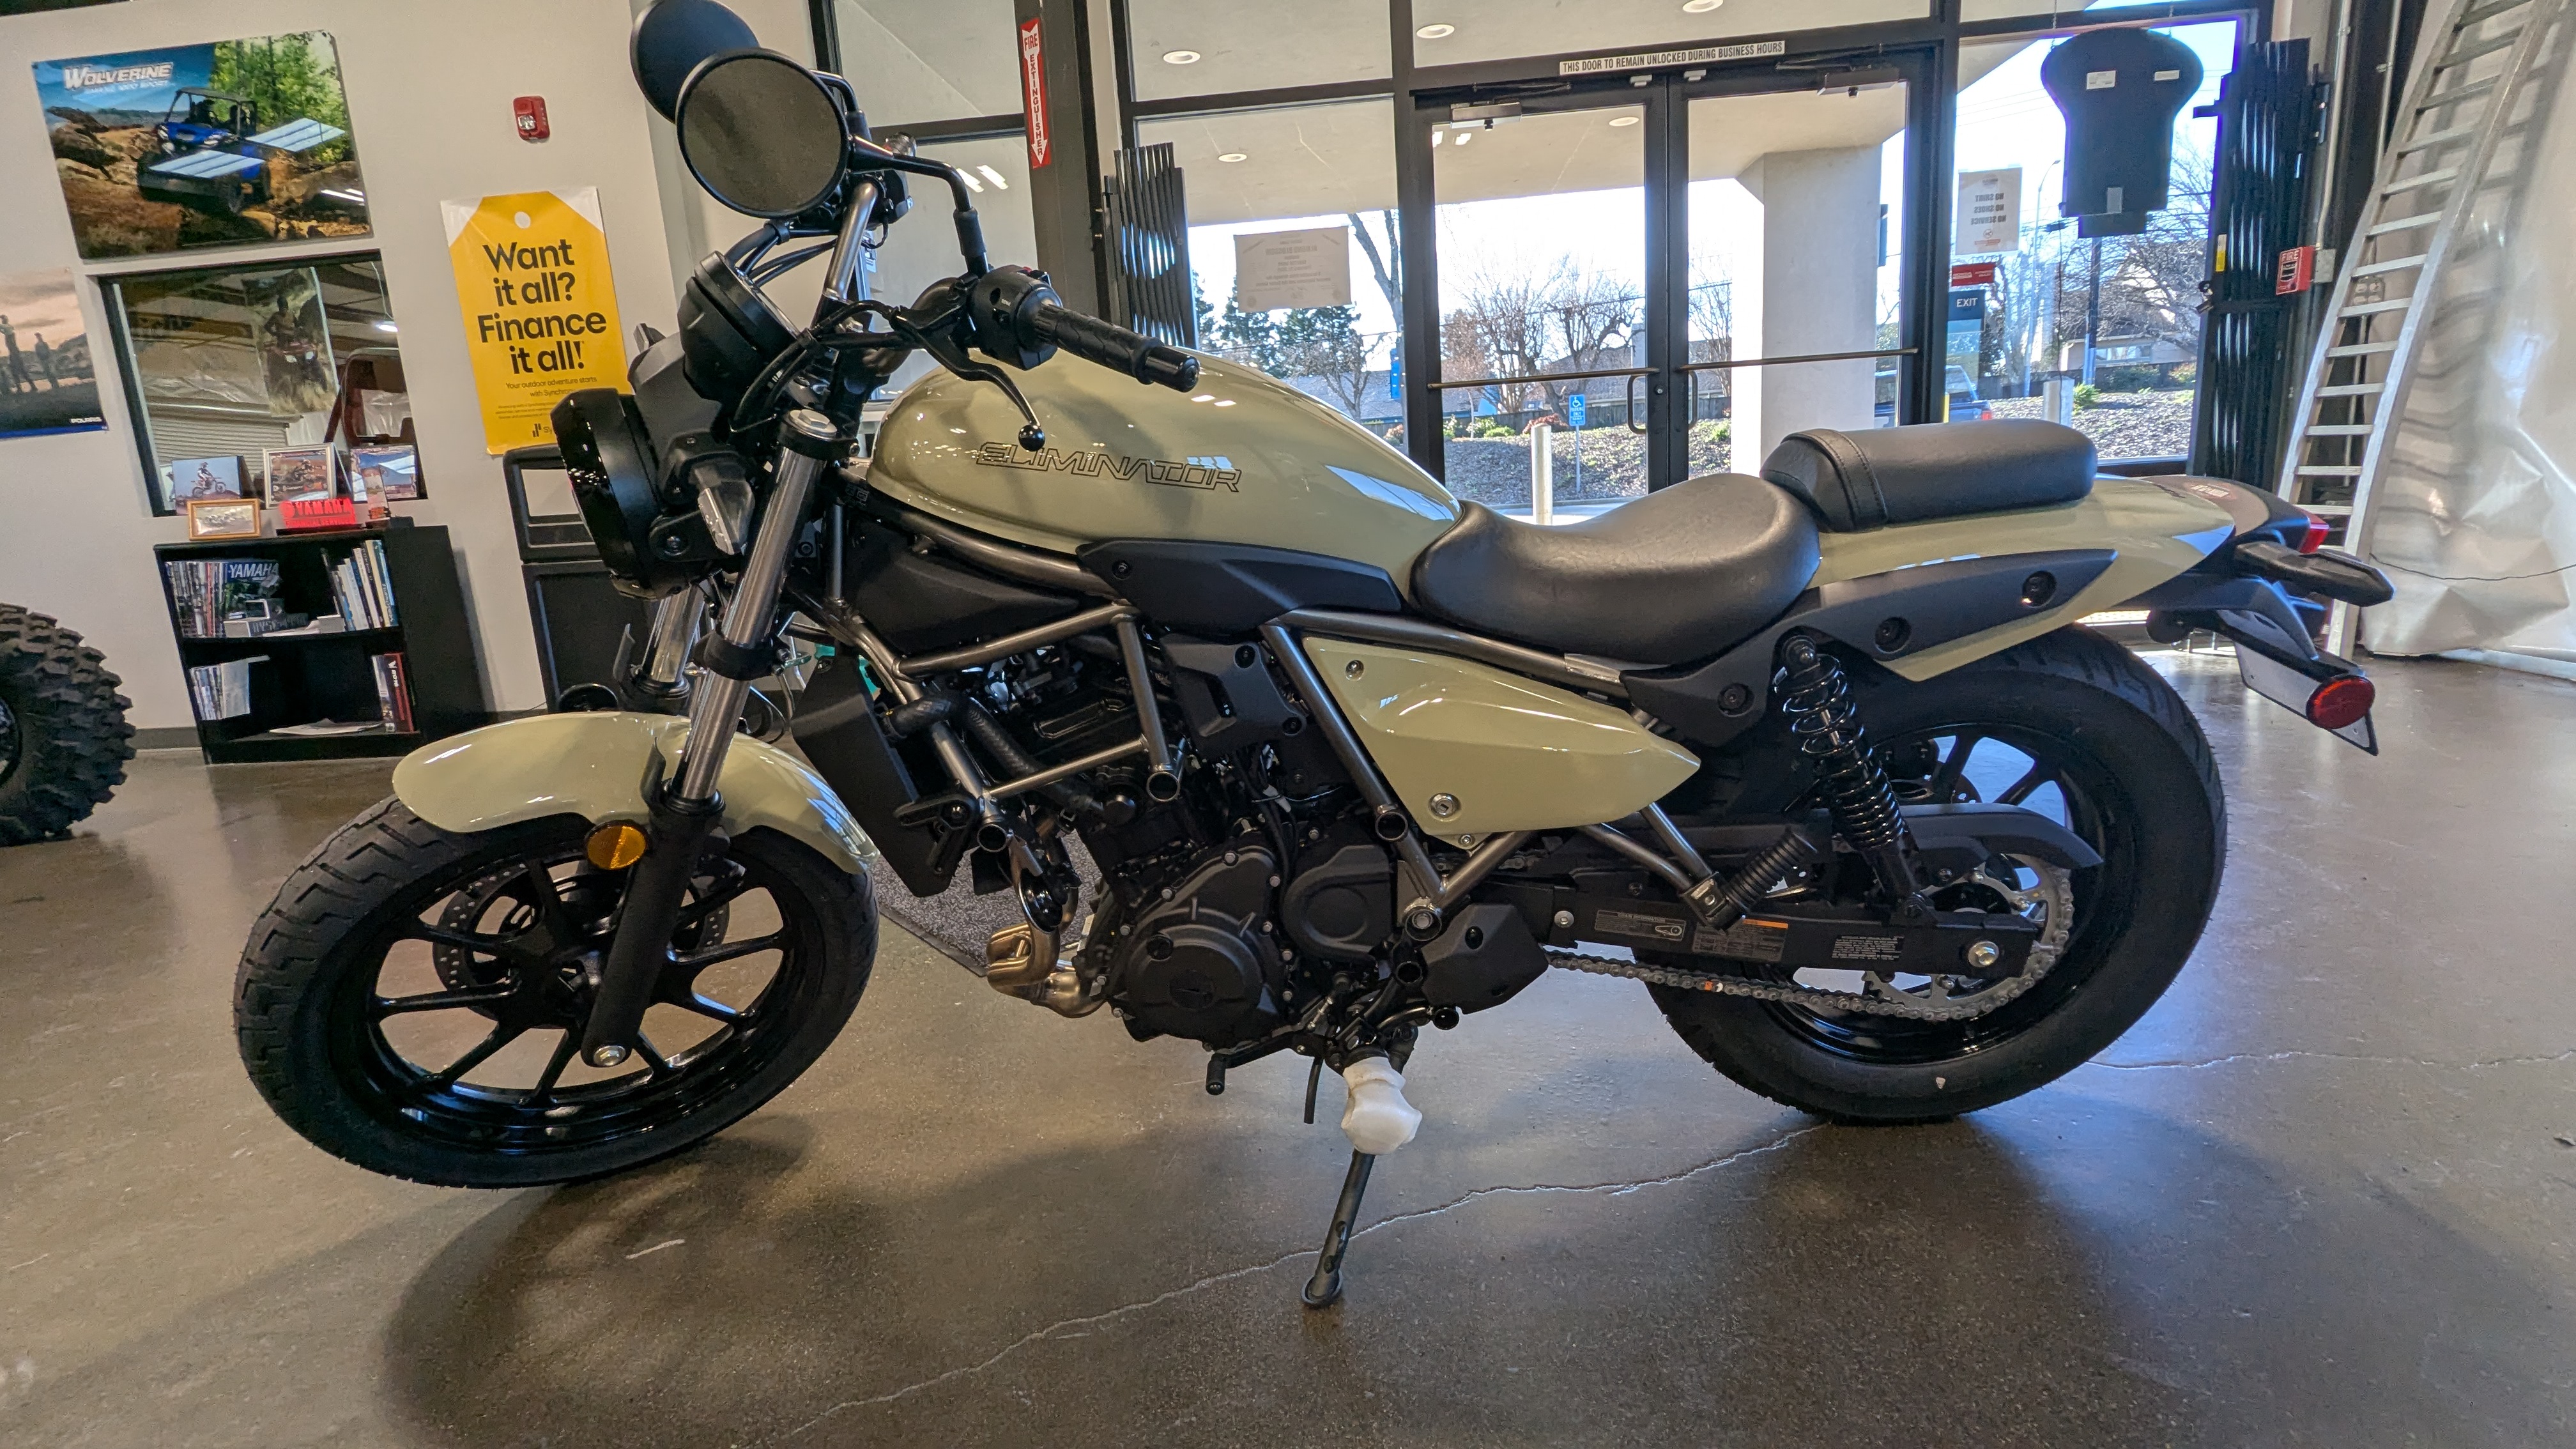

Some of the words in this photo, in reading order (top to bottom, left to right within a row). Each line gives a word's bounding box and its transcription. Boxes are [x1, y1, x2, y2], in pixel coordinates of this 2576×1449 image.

[1024, 34, 1038, 49] FIRE
[1563, 61, 1579, 73] THIS
[1582, 59, 1602, 71] DOOR
[1604, 58, 1614, 68] TO
[1616, 55, 1645, 68] REMAIN
[1646, 51, 1686, 65] UNLOCKED
[1688, 49, 1715, 61] DURING
[1718, 45, 1754, 58] BUSINESS
[1757, 42, 1782, 54] HOURS
[65, 62, 173, 88] WOLVERINE
[1029, 54, 1043, 156] EXTINGUISHER
[482, 239, 575, 273] Want
[2281, 250, 2300, 262] FIRE
[493, 277, 518, 307] it
[521, 272, 576, 304] all?
[1956, 298, 1978, 307] EXIT
[477, 312, 607, 343] Finance
[509, 345, 534, 374] it
[537, 340, 585, 372] all!
[544, 388, 574, 397] Synchron
[548, 378, 578, 386] adventure
[976, 441, 1242, 493] ELIMINATOR
[295, 498, 353, 516] YAMAHA
[230, 562, 280, 578] YAMAHA
